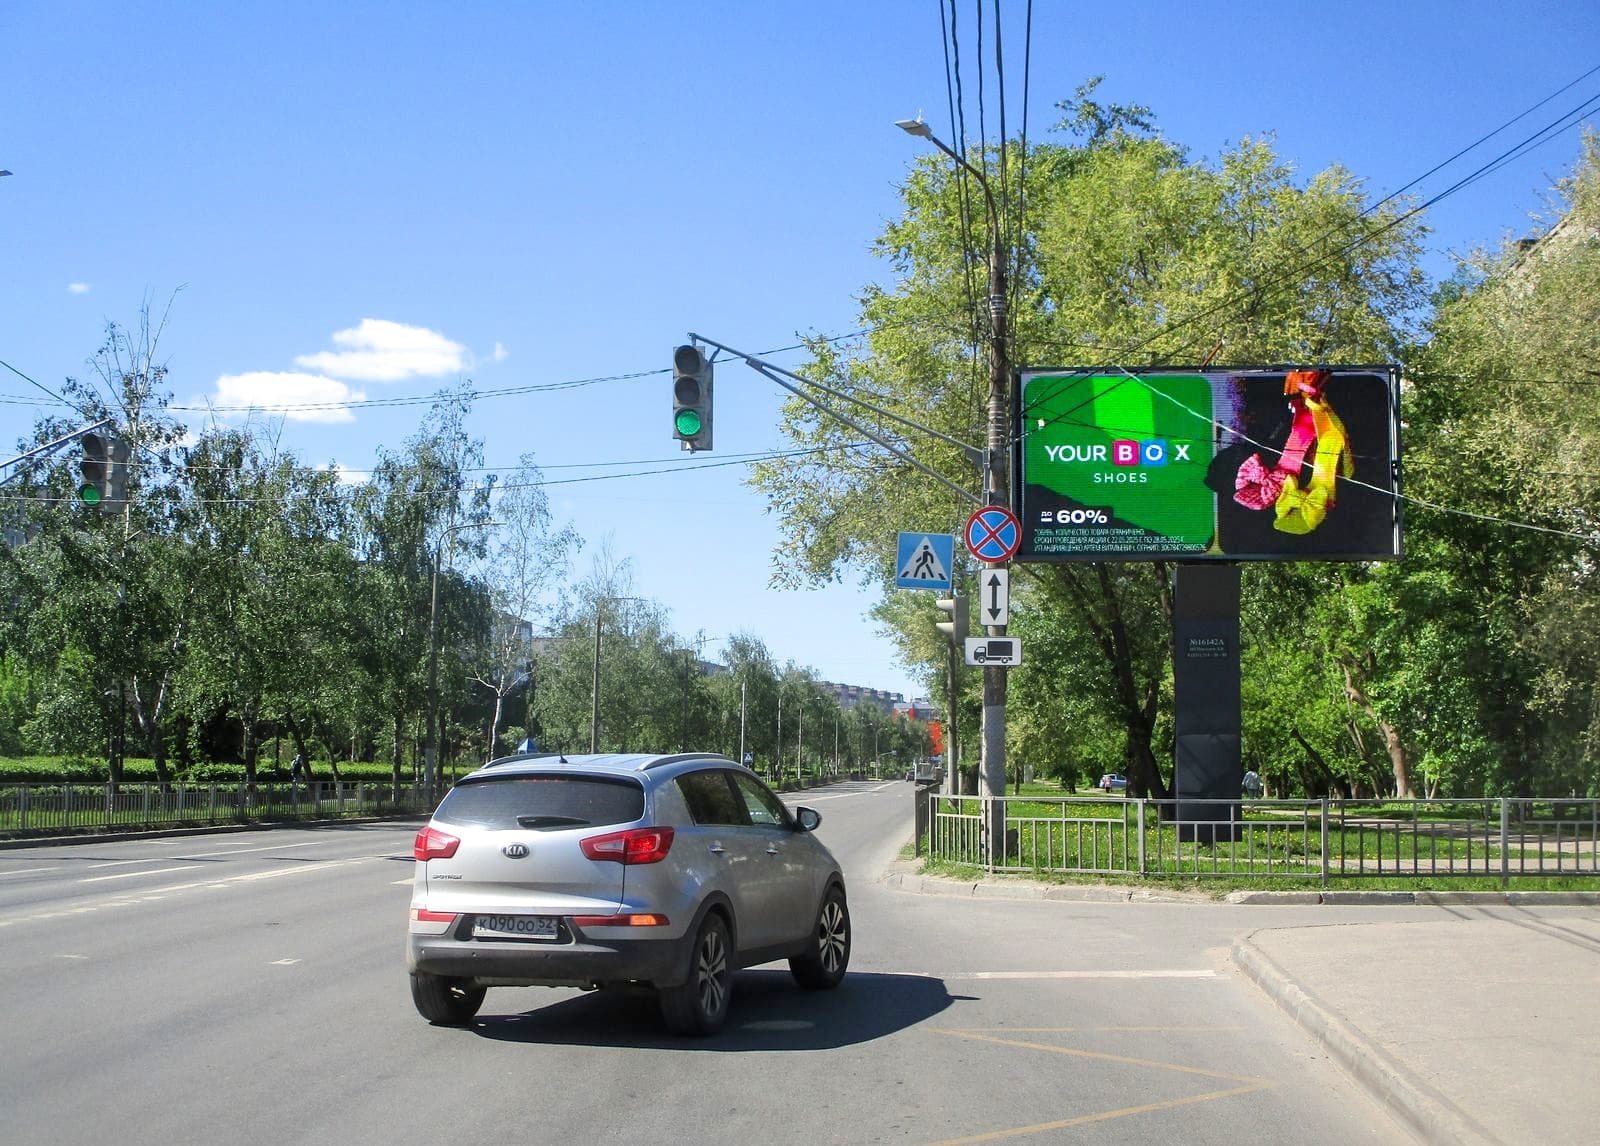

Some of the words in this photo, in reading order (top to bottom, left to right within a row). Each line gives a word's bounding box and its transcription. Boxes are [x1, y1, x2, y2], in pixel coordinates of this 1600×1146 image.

[1045, 445, 1107, 462] YOUR
[1093, 472, 1148, 483] SHOES
[1056, 510, 1108, 524] 60%
[505, 846, 525, 855] KIA
